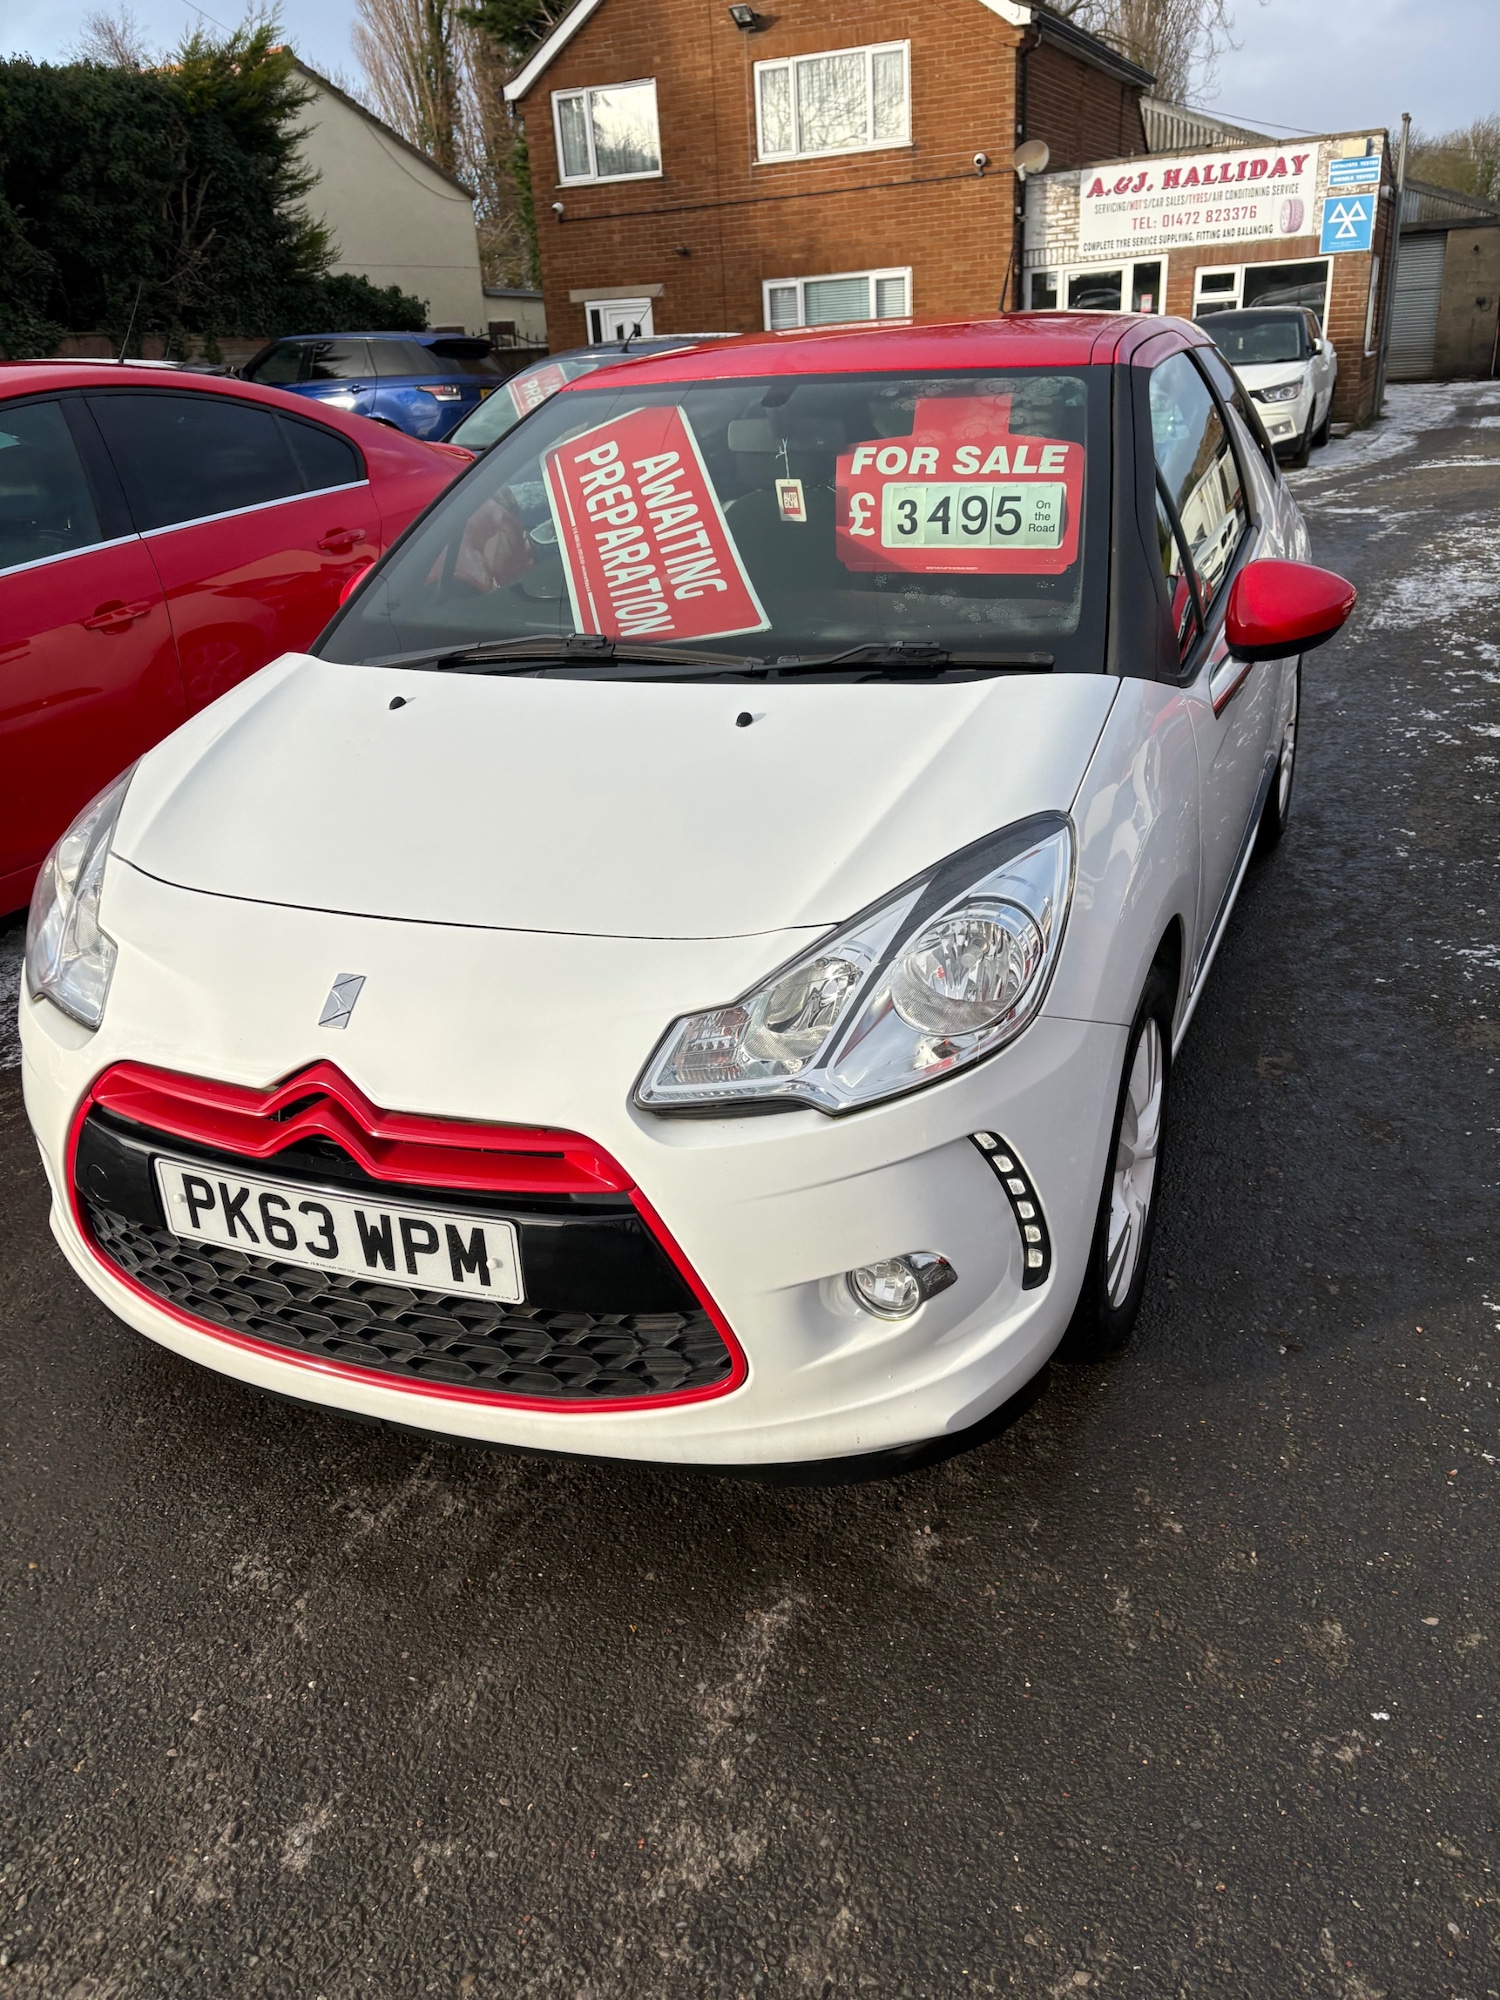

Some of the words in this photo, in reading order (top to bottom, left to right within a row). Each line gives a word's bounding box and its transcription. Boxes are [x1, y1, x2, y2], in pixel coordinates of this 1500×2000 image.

[1161, 153, 1311, 190] HALLIDAY
[1225, 185, 1270, 201] CONDITIONING
[1272, 182, 1299, 196] SERVICE
[1132, 216, 1157, 230] TEL:
[1162, 211, 1200, 227] 01472
[1205, 205, 1257, 223] 823376
[1083, 240, 1115, 252] COMPLETE
[1116, 237, 1131, 249] TYRE
[1132, 235, 1158, 247] SERVICE
[1159, 231, 1195, 244] SUPPLYING,
[1196, 228, 1221, 241] FITTING
[1222, 227, 1236, 238] AND
[1237, 223, 1273, 237] BALANCING
[850, 446, 940, 475] FOR
[952, 445, 1069, 474] SALE
[897, 496, 1022, 535] 3495
[1034, 511, 1051, 521] the
[1035, 500, 1051, 510] On
[574, 440, 676, 637] PREPARATION
[632, 450, 728, 600] AWAITING
[1028, 523, 1056, 533] Road
[181, 1173, 340, 1260] PK63
[354, 1210, 492, 1288] WPM
